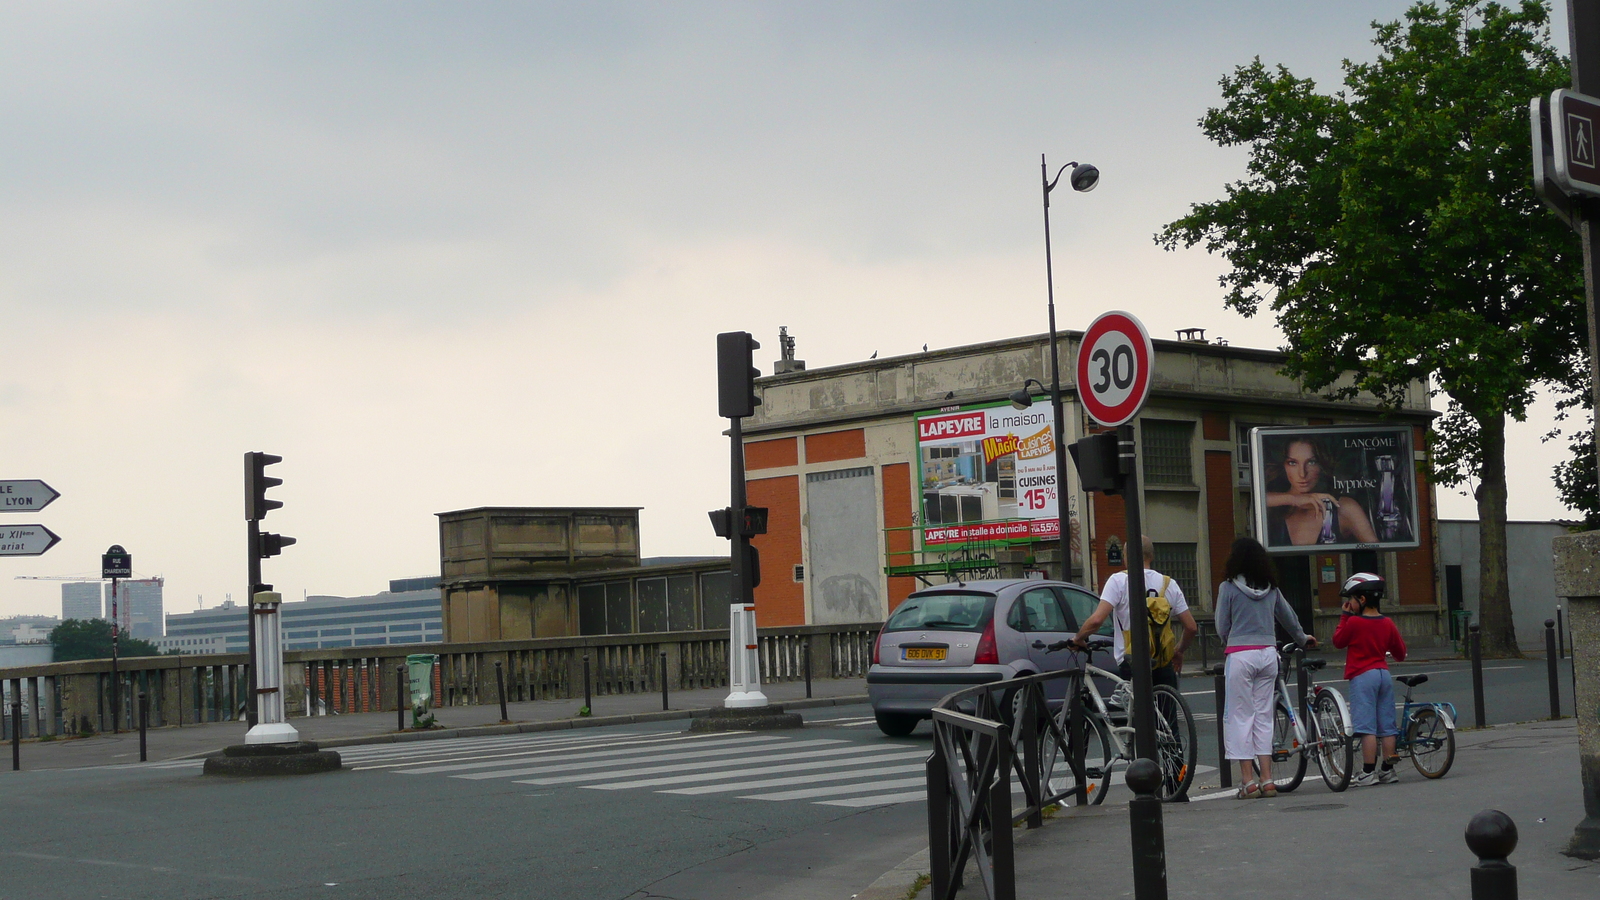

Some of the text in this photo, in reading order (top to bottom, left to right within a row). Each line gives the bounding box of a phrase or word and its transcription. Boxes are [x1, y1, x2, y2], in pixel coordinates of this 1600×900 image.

[1091, 344, 1134, 394] 30
[920, 416, 982, 437] LAPEYRE
[990, 416, 999, 429] la
[1017, 430, 1053, 451] Cuisines
[1344, 437, 1395, 448] LANCÔME
[1021, 443, 1052, 458] LAPEYRE
[1019, 475, 1056, 487] CUISINES
[6, 497, 32, 505] LYON
[925, 529, 959, 541] LAPEYRE
[961, 526, 988, 537] installe
[990, 526, 995, 534] à
[996, 523, 1028, 534] domicile
[935, 649, 944, 658] 91
